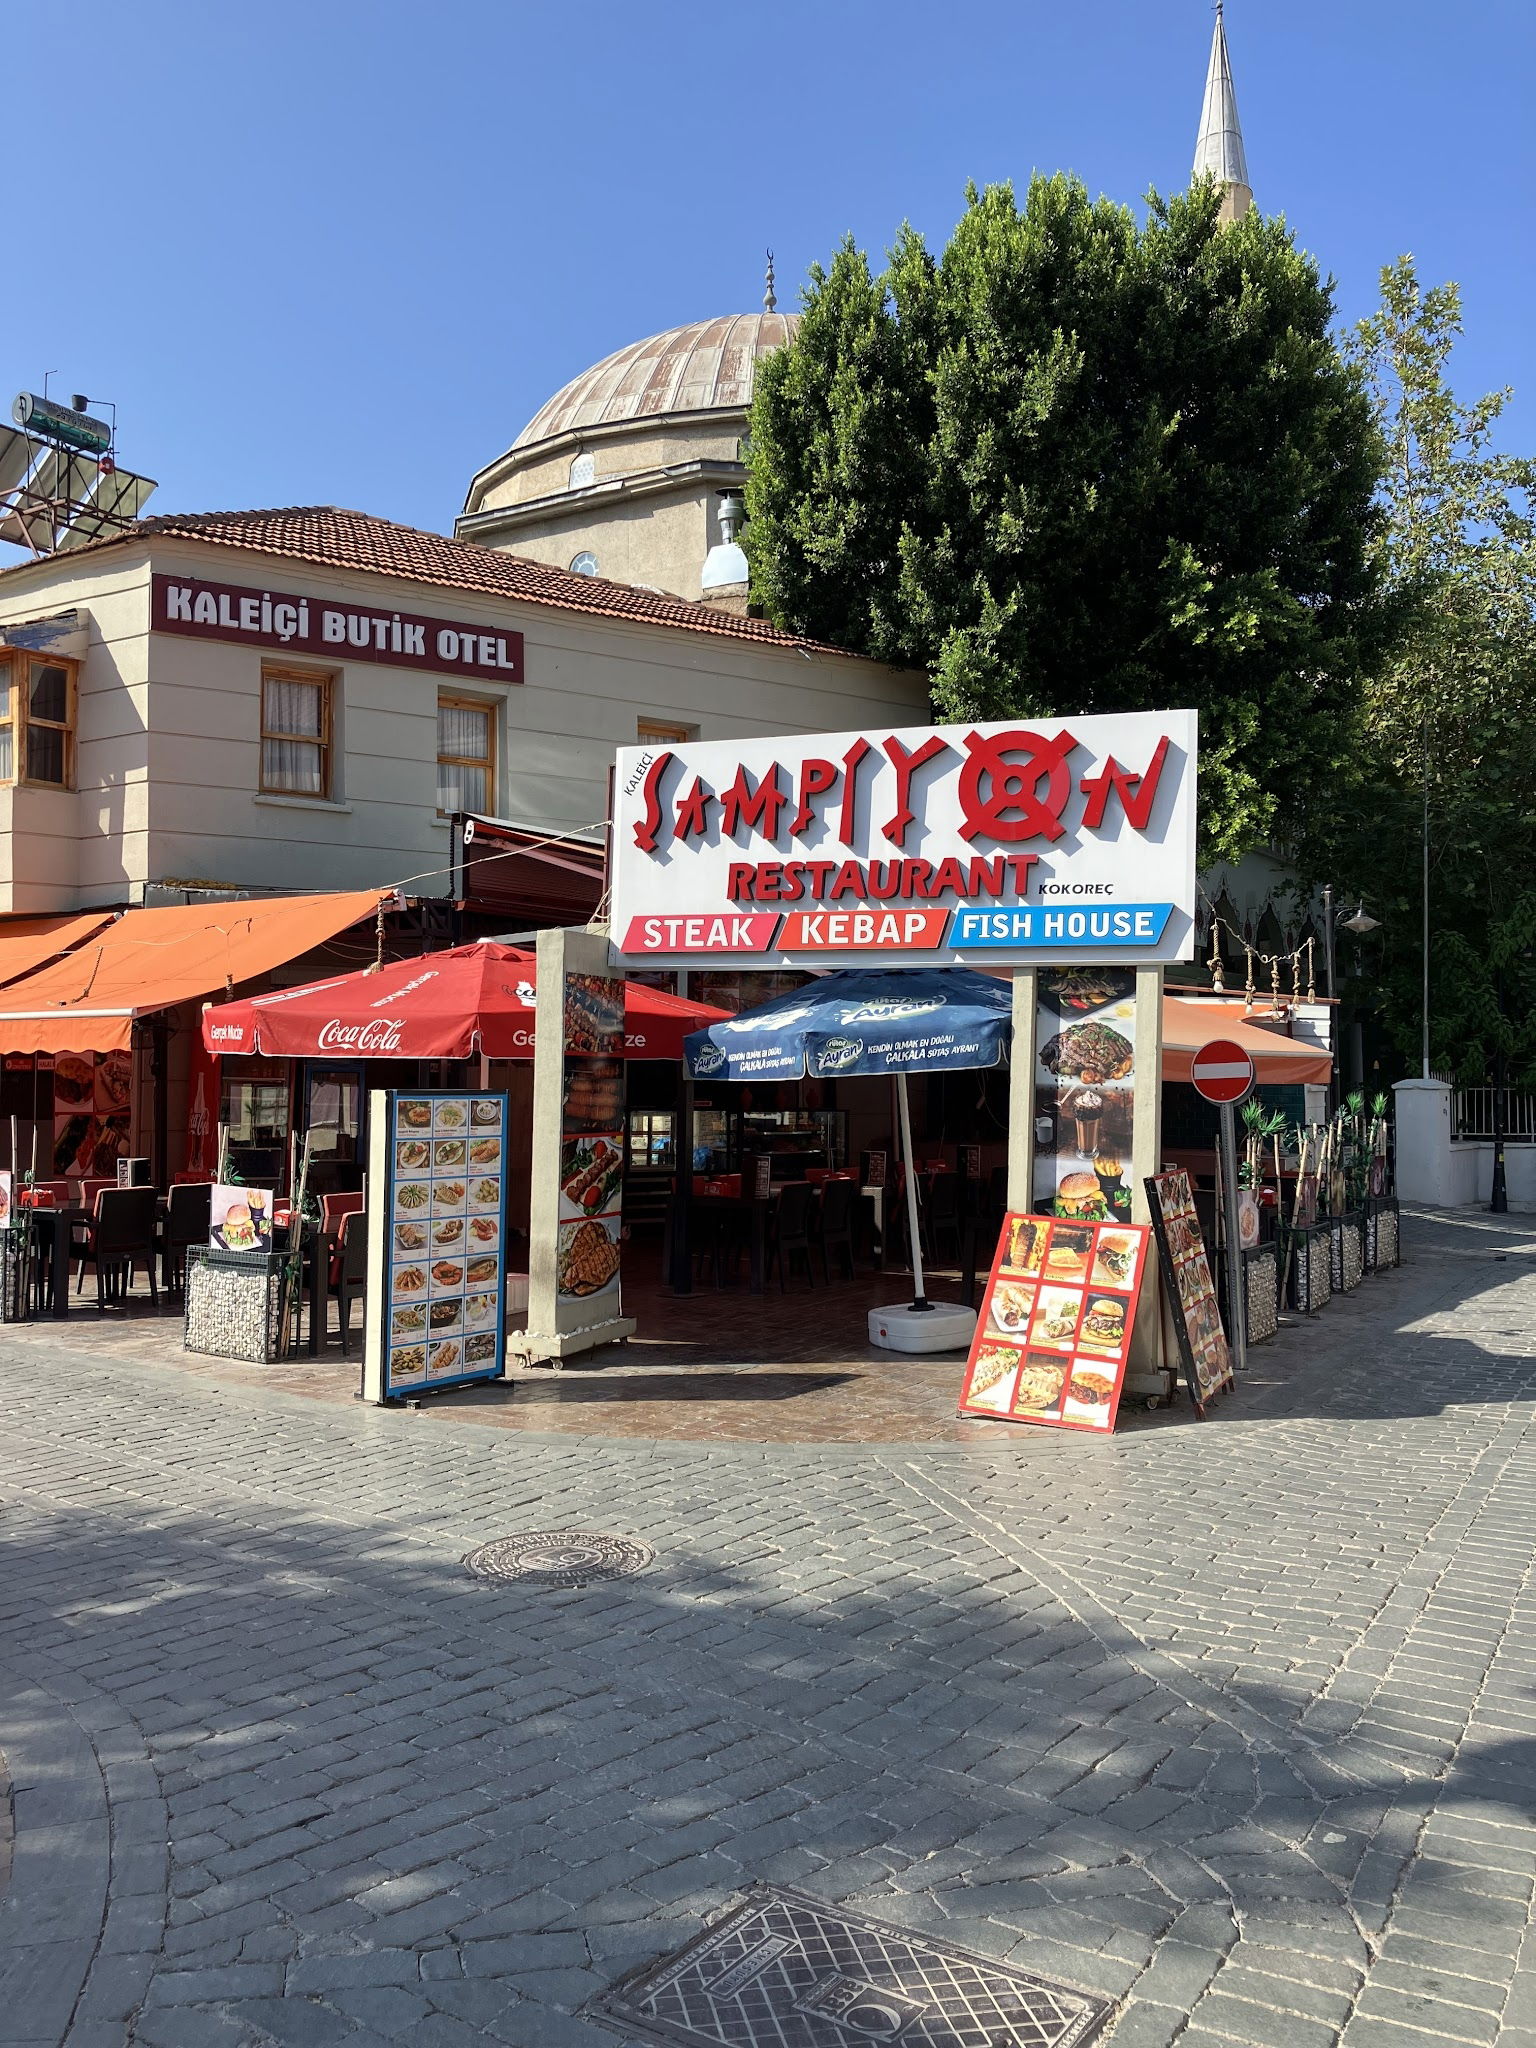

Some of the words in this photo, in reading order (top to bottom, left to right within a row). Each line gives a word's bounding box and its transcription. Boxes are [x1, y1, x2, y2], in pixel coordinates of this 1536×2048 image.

[167, 585, 309, 641] KALEİÇİ
[322, 613, 426, 656] BUTİK
[437, 628, 514, 669] OTEL
[624, 752, 654, 796] KALEİÇİ
[727, 854, 1040, 900] RESTAURANT
[1038, 884, 1114, 896] KOKOREÇ
[643, 917, 754, 948] STEAK
[801, 913, 927, 944] KEBAP
[962, 913, 1032, 938] FISH
[1044, 911, 1154, 938] HOUSE
[852, 999, 934, 1019] Ayran
[318, 1019, 406, 1050] Coca-Cola
[868, 1043, 893, 1054] KENDİN
[895, 1041, 918, 1051] OLMAK
[919, 1039, 930, 1048] EN
[697, 1051, 724, 1070] Ayran
[823, 1044, 858, 1067] Ayran
[885, 1049, 926, 1065] ÇALKALA
[927, 1048, 950, 1059] SÜTAŞ
